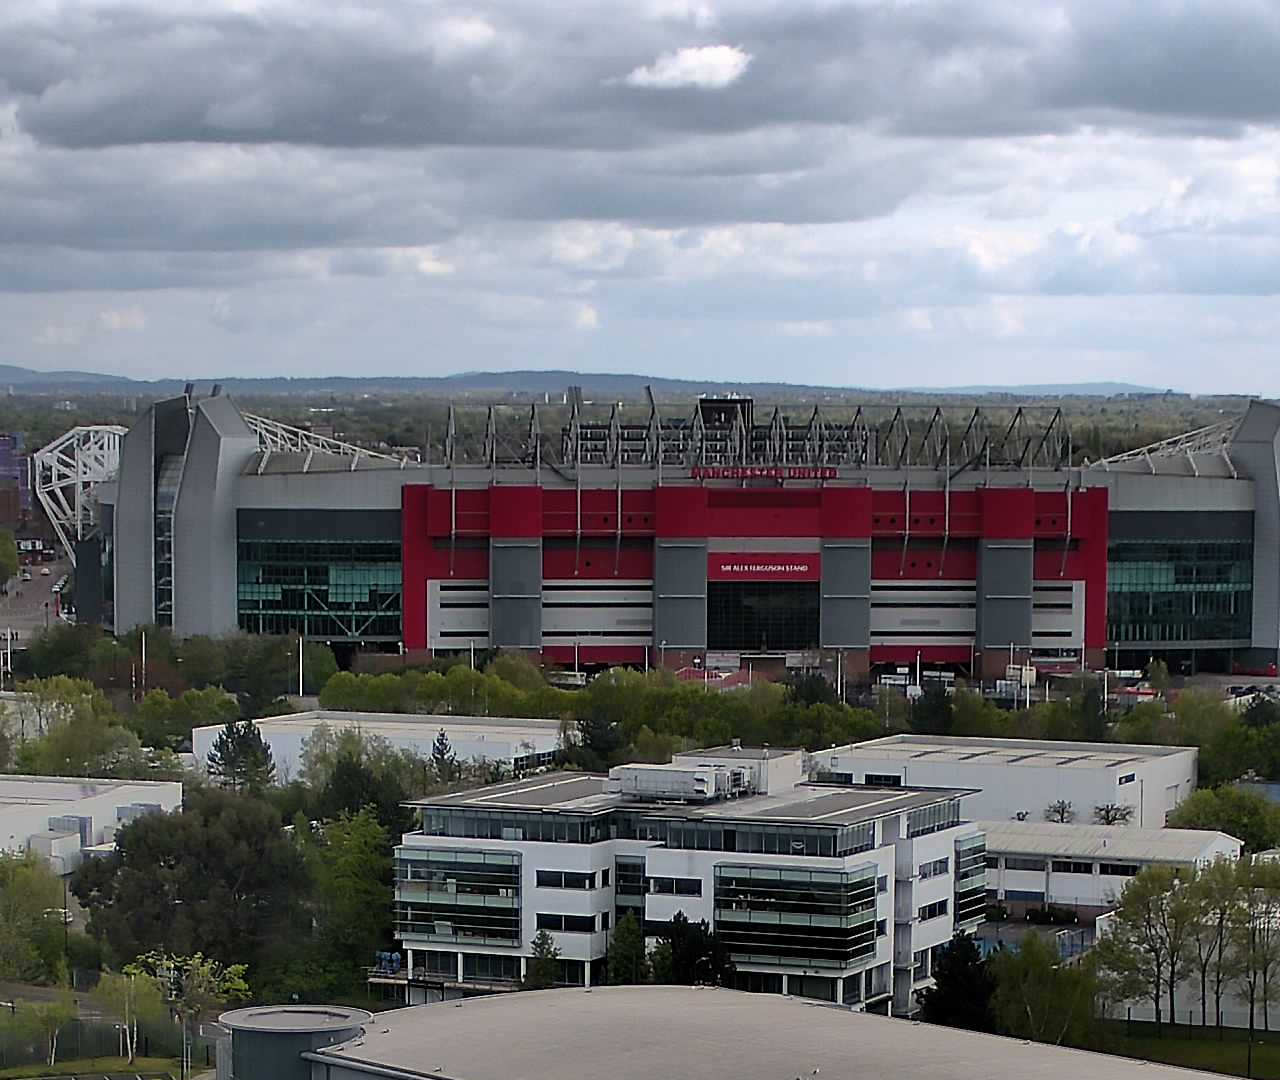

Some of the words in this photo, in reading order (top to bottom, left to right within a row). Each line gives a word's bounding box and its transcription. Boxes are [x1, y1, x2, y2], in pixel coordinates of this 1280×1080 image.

[691, 466, 784, 479] MANCHESTER
[788, 467, 839, 479] UNITED
[721, 564, 731, 572] SIR
[733, 564, 749, 572] ALEX
[750, 564, 784, 572] FERGUSON
[786, 564, 808, 572] STAND
